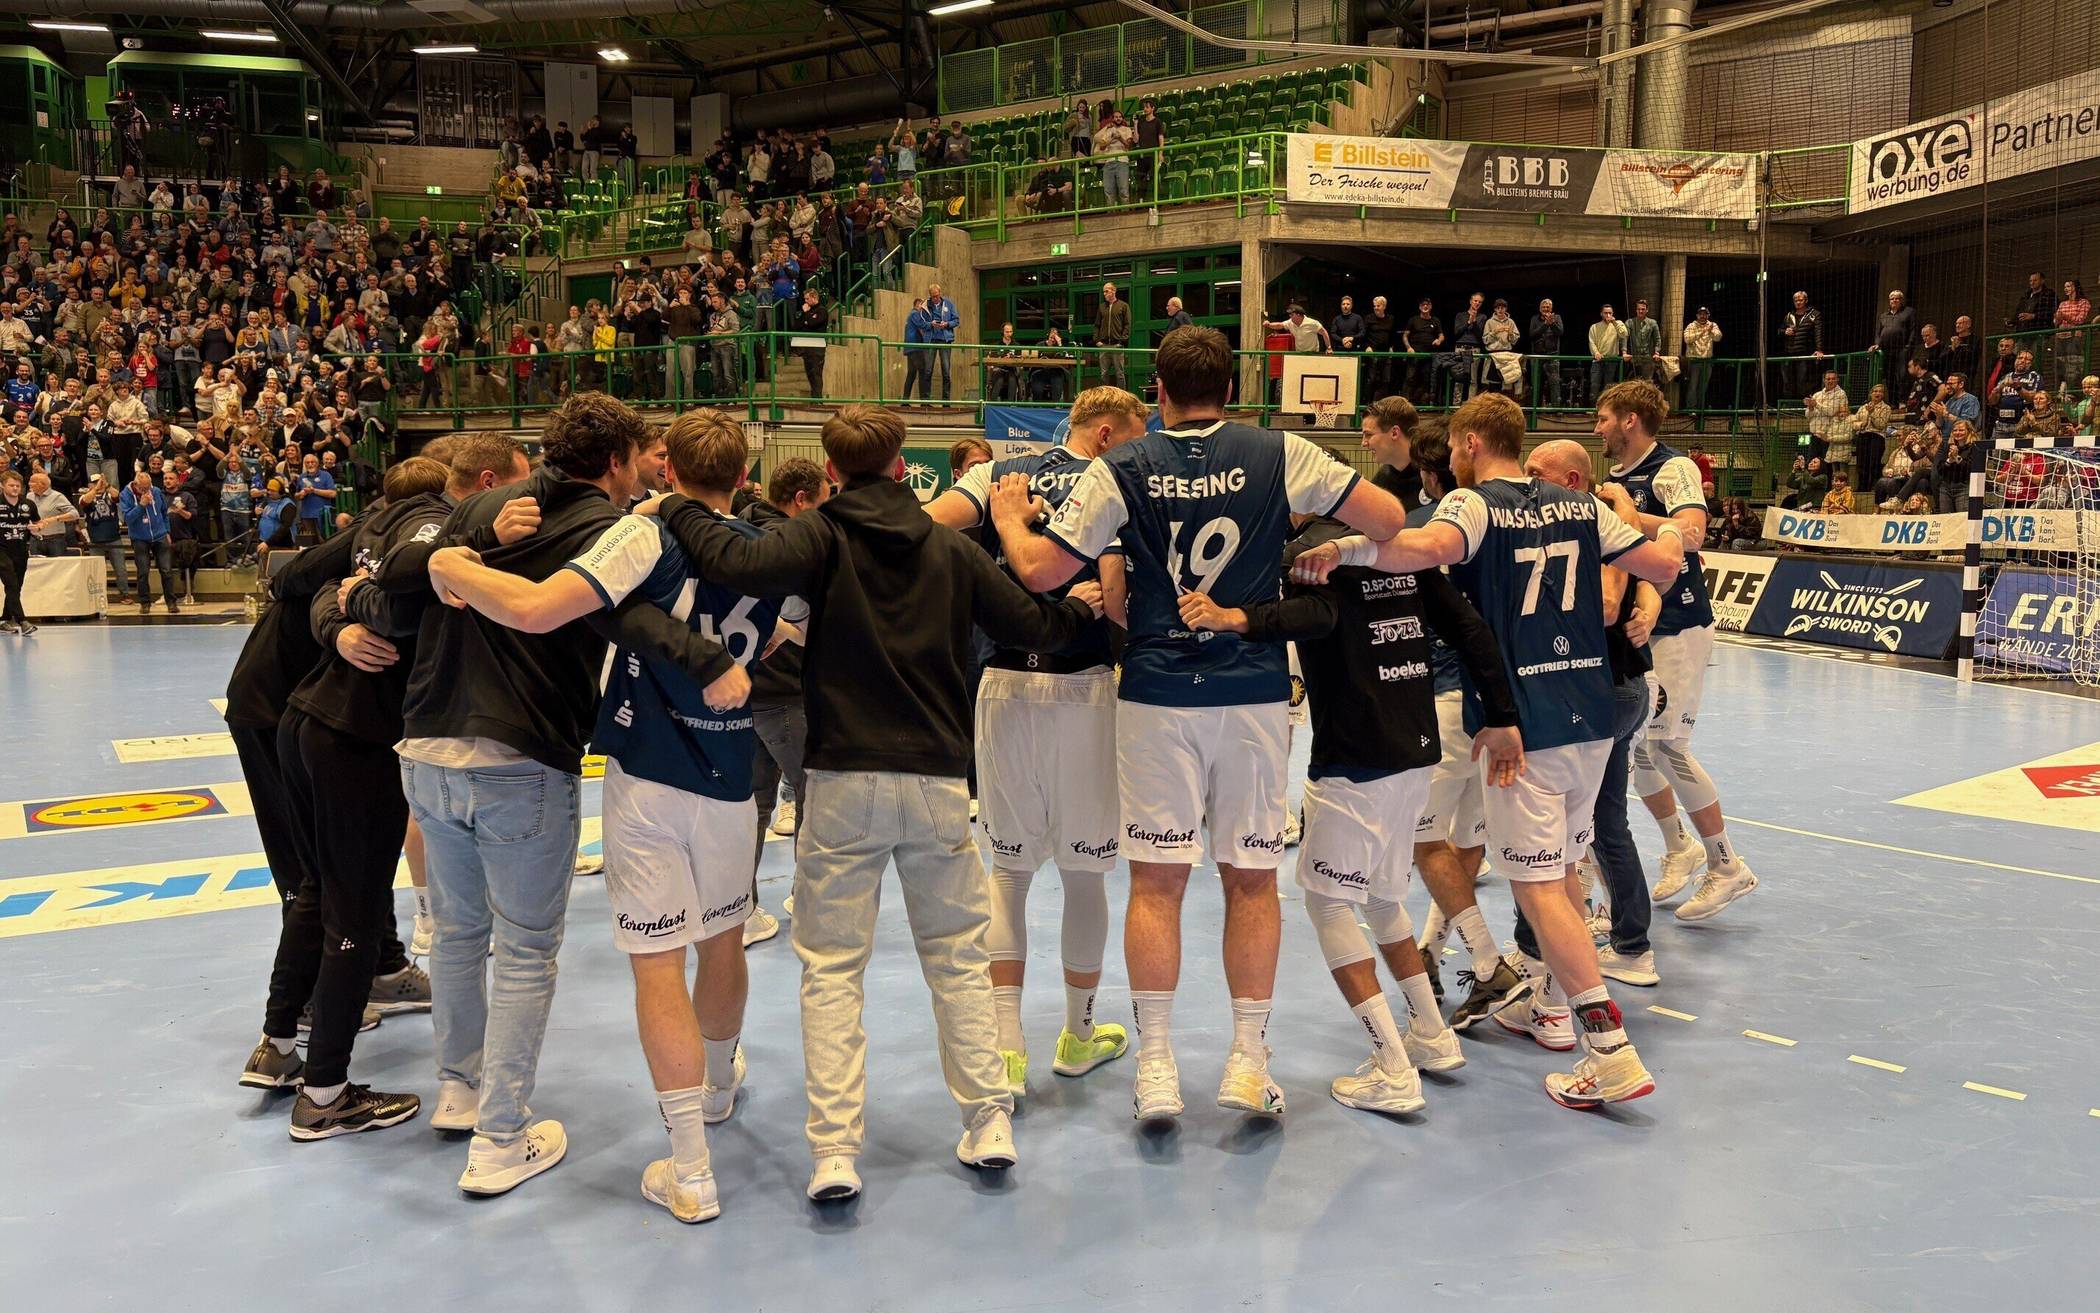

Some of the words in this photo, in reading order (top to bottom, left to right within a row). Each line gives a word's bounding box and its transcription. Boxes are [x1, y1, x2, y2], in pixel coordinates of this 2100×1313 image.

[1342, 144, 1430, 168] Billstein
[1620, 163, 1667, 174] Billstein
[1309, 173, 1334, 187] Der
[1336, 174, 1383, 190] Frische
[1386, 178, 1429, 194] wegen!
[1866, 163, 1970, 201] werbung.de
[1496, 187, 1528, 197] BILLSTEINS
[1528, 188, 1553, 198] BREMME
[1553, 188, 1569, 199] BRÄU
[1008, 427, 1030, 438] Blue
[1148, 467, 1246, 500] SEESING
[1778, 514, 1826, 541] DKB
[1881, 521, 1928, 544] DKB
[1982, 515, 2035, 543] DKB
[1513, 539, 1580, 617] 77
[1843, 583, 1865, 593] SINCE
[1866, 586, 1884, 595] 1772
[1712, 601, 1749, 618] Schaum
[1790, 588, 1931, 624] WILKINSON
[1818, 616, 1872, 634] SWORD
[1027, 653, 1038, 668] 8
[1517, 660, 1569, 677] GOTTFRIED
[1125, 823, 1195, 845] Coroplast
[1500, 847, 1562, 866] Coroplast
[616, 909, 686, 936] Coroplast
[1456, 925, 1469, 945] CRAFT
[1362, 1015, 1377, 1039] CRAFT
